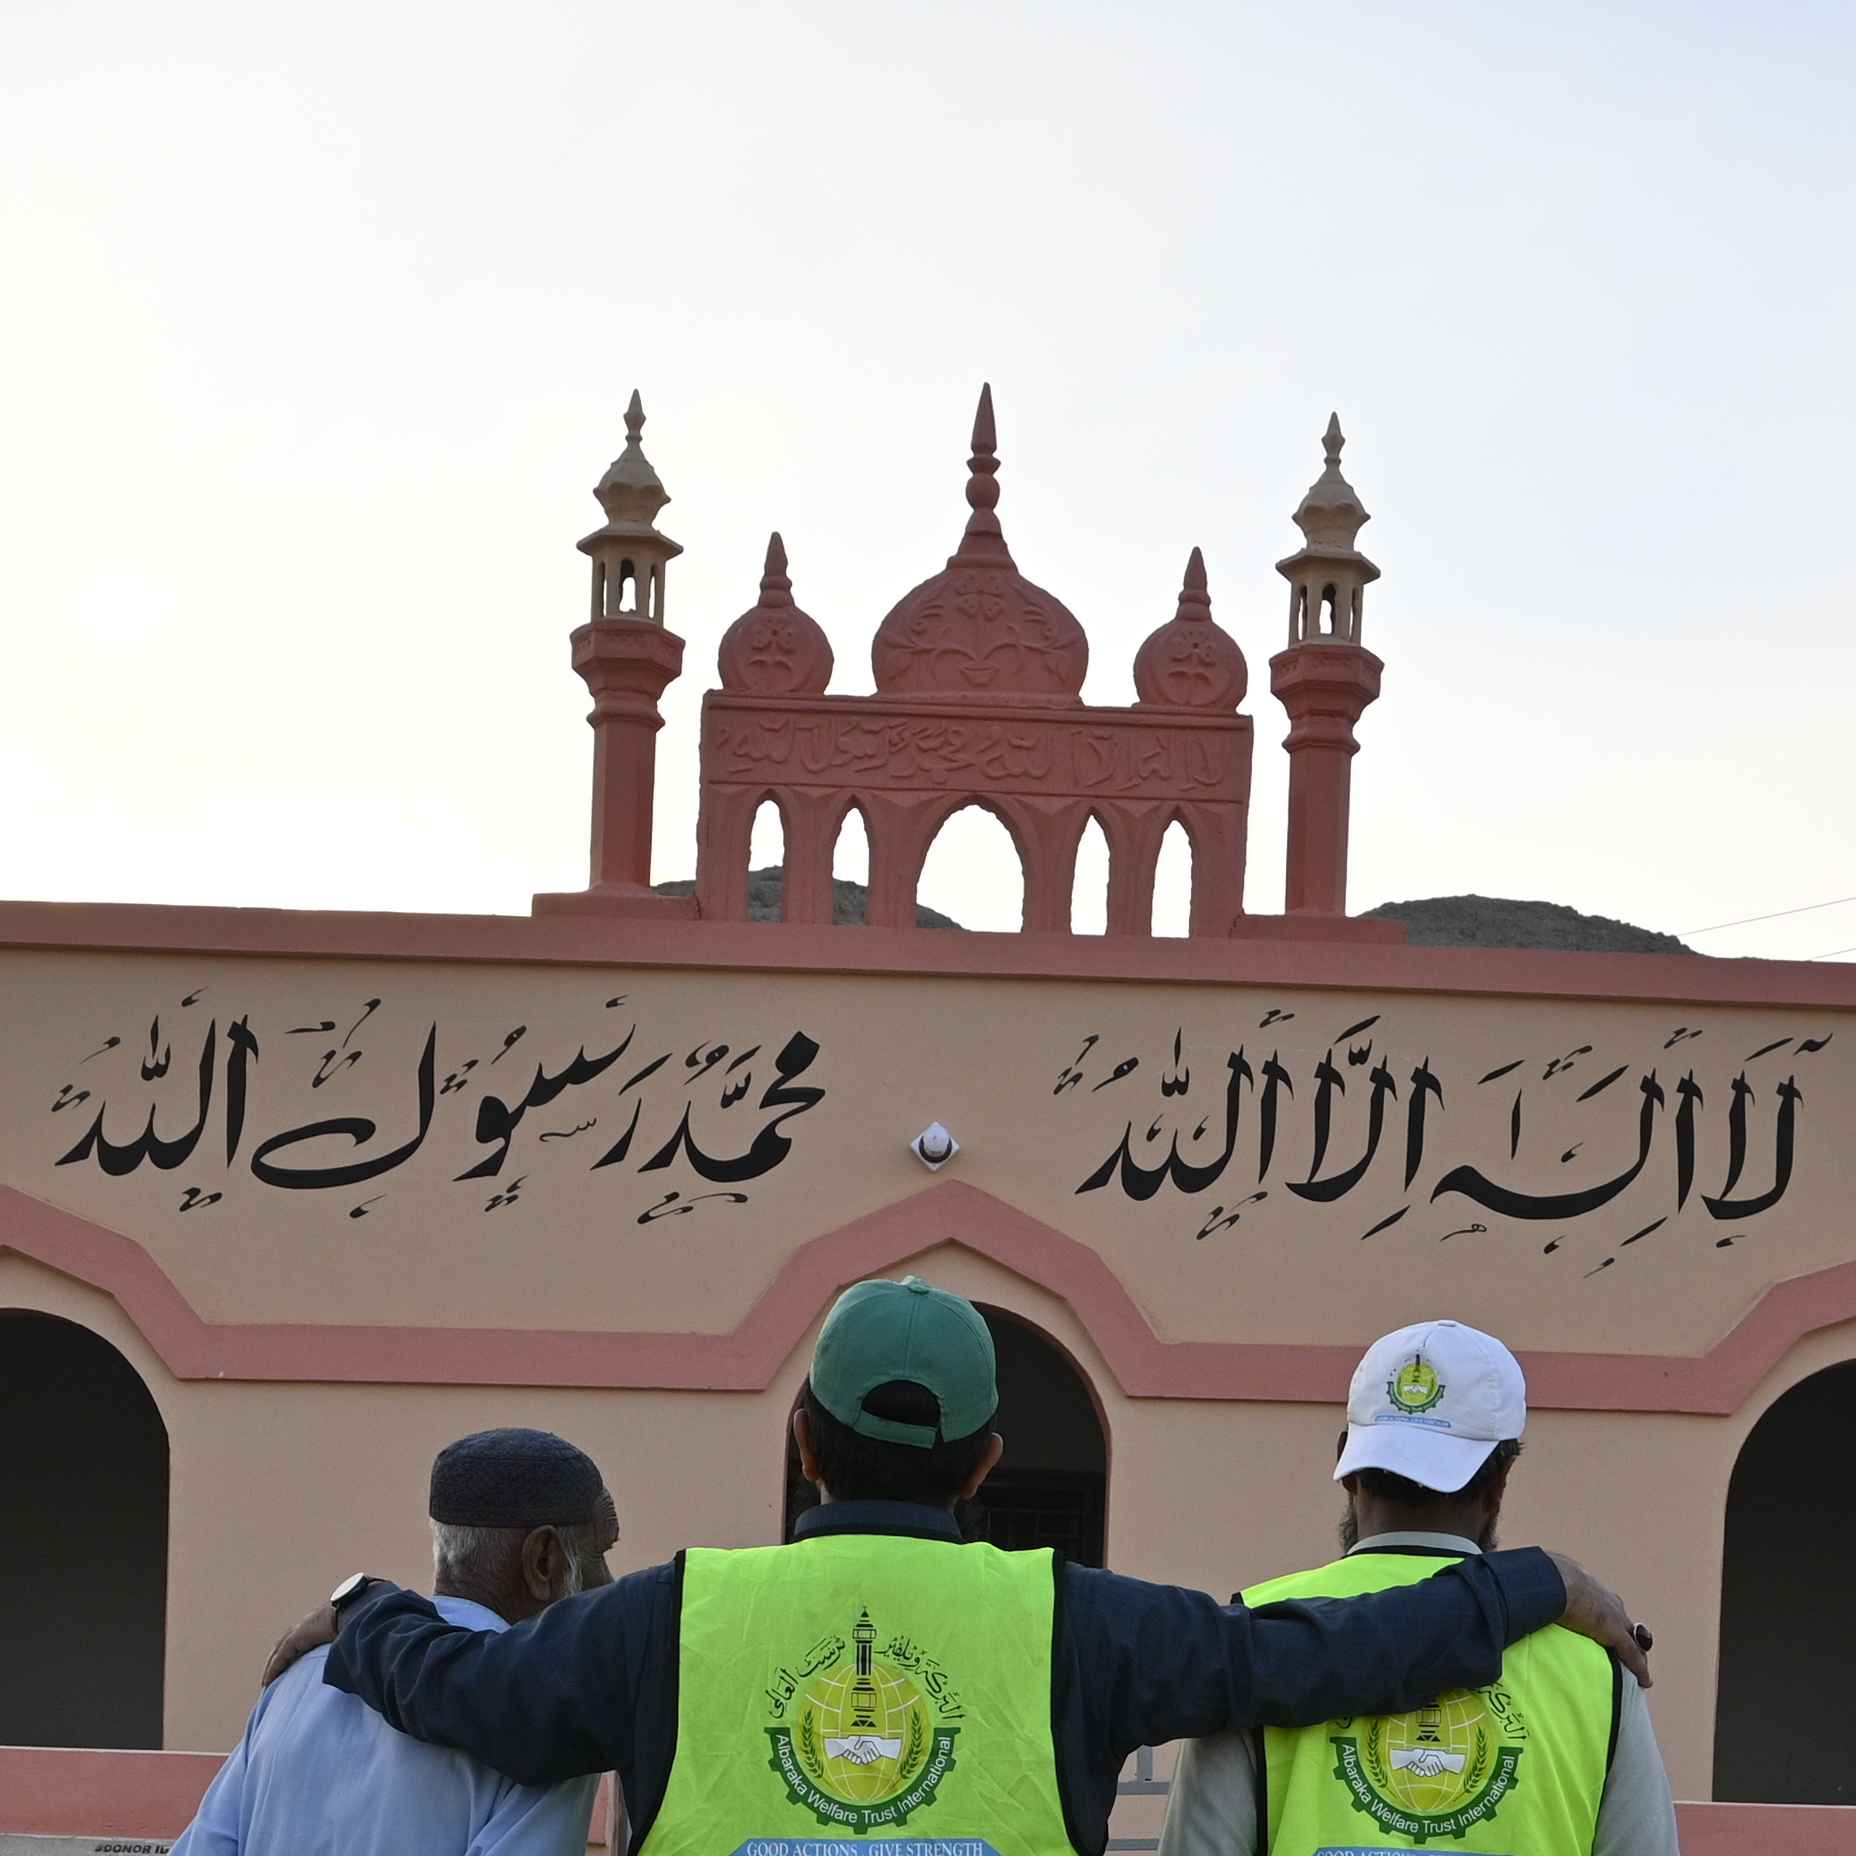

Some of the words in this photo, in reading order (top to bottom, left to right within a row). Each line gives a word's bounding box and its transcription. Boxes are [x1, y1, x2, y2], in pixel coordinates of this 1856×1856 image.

[775, 1734, 808, 1796] Albaraka
[807, 1790, 858, 1823] Welfare
[861, 1806, 898, 1824] Trust
[896, 1736, 952, 1813] International
[1341, 1743, 1372, 1803] Albaraka
[1371, 1799, 1419, 1834] Welfare
[1422, 1818, 1457, 1835] Trust
[1456, 1755, 1516, 1828] International
